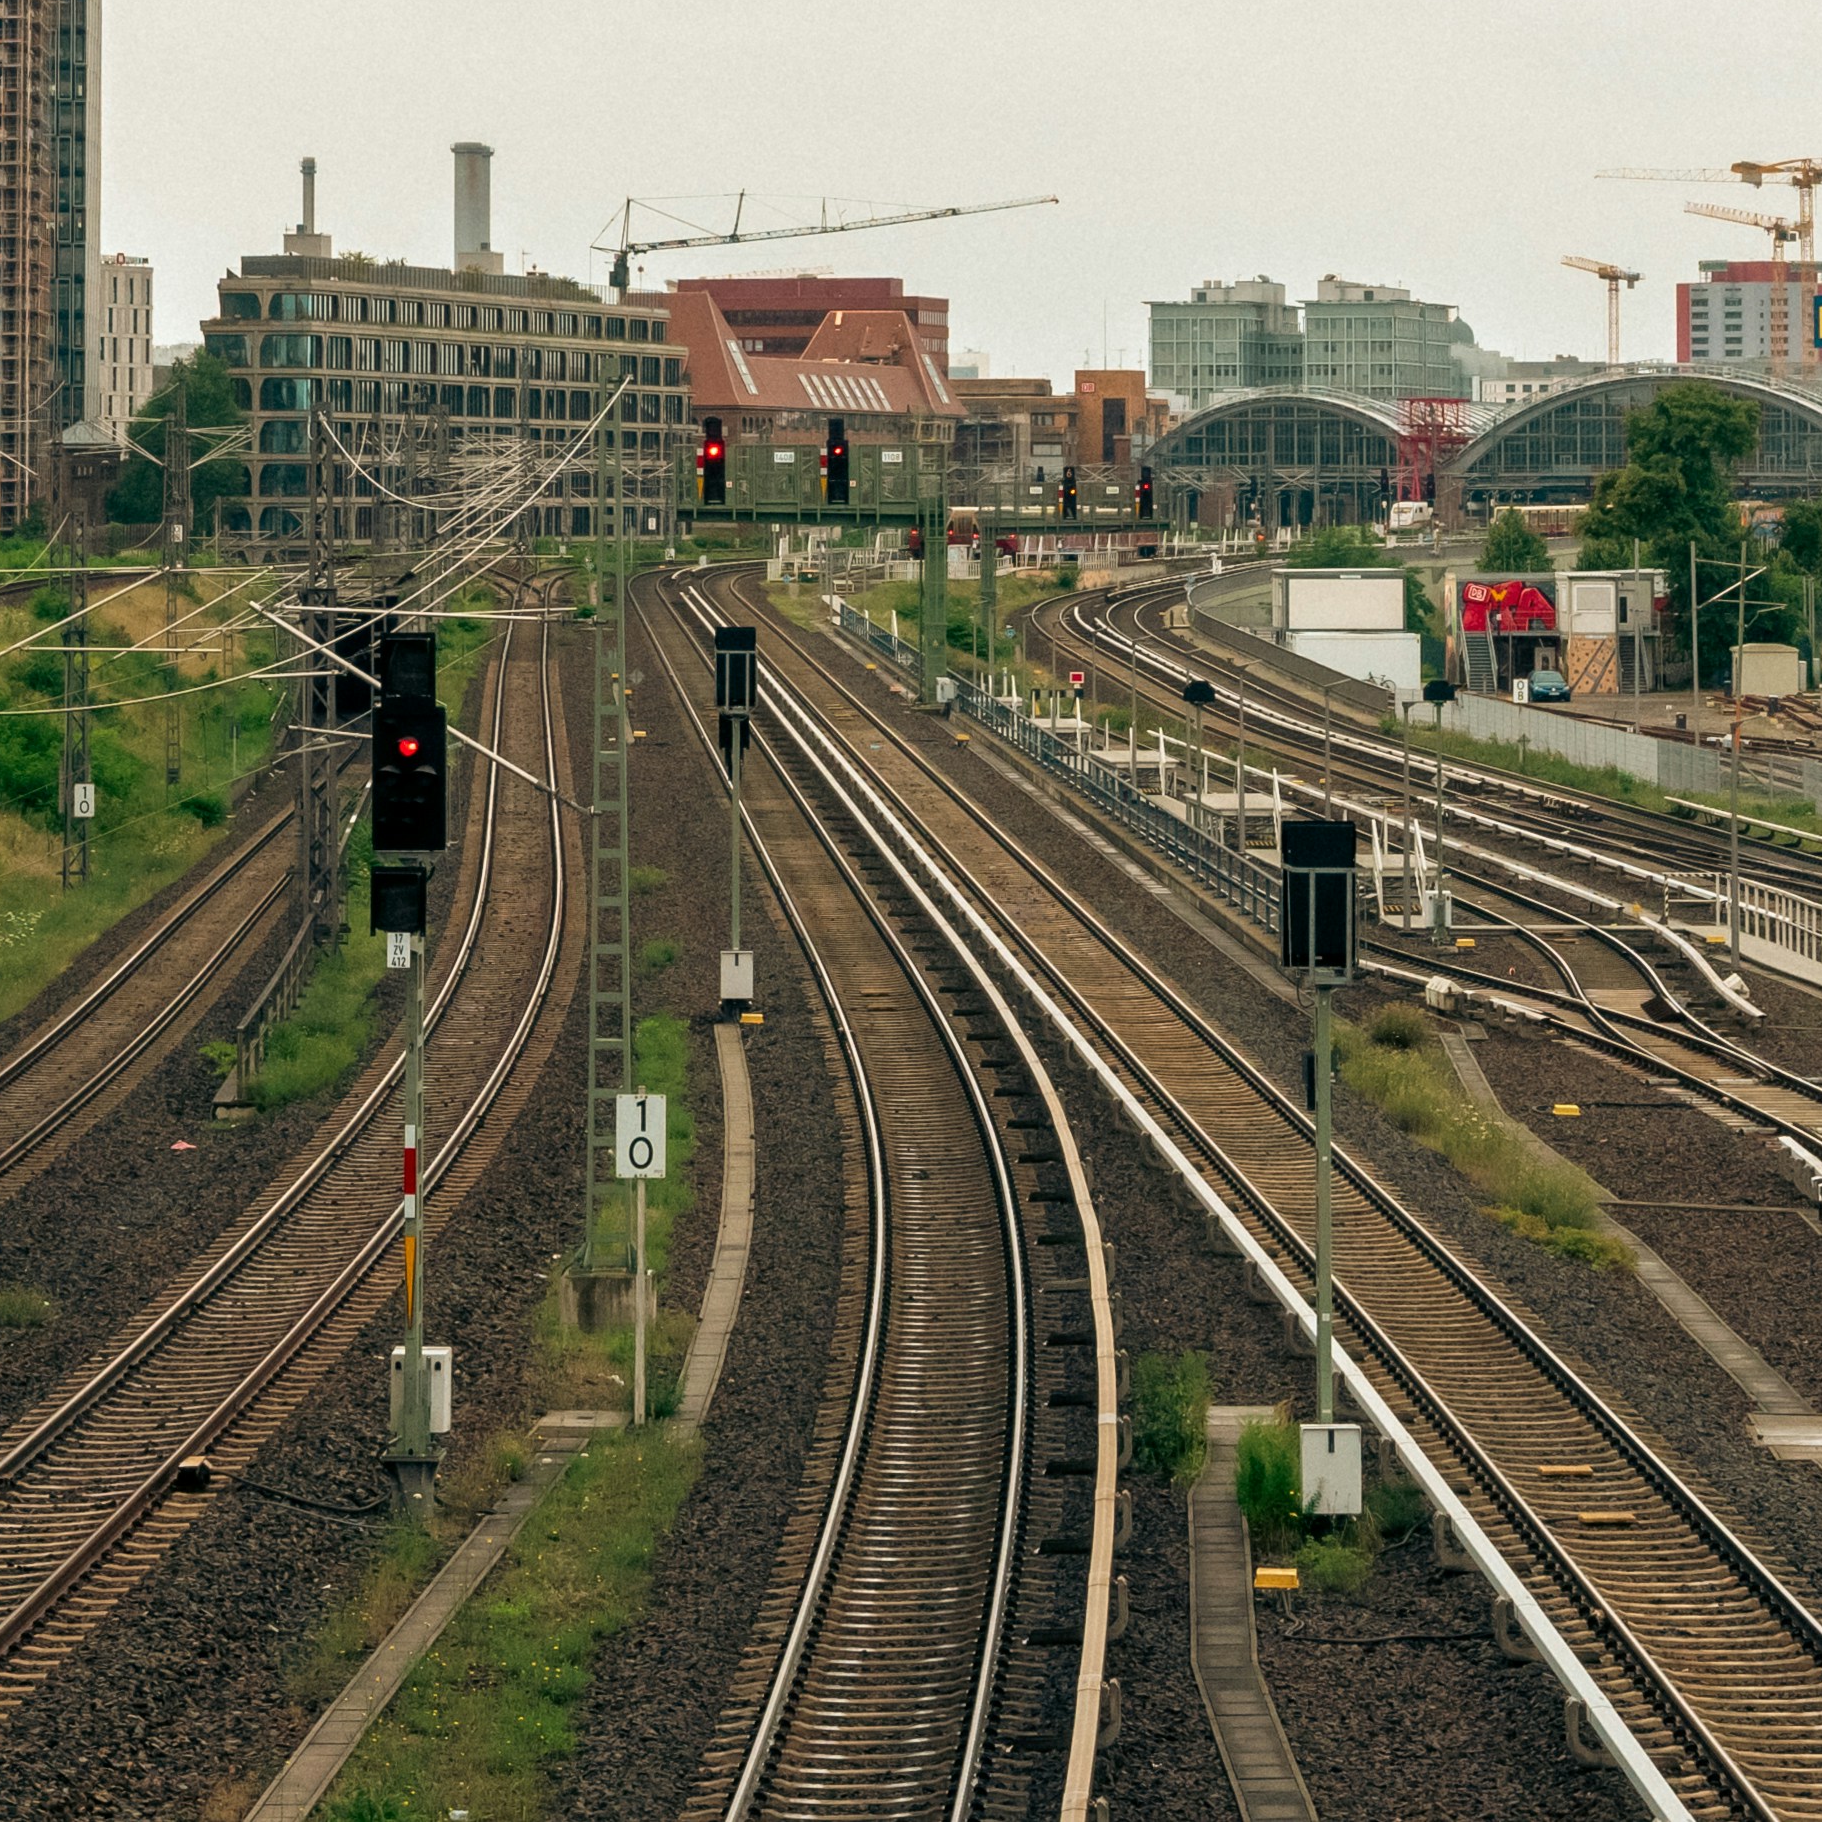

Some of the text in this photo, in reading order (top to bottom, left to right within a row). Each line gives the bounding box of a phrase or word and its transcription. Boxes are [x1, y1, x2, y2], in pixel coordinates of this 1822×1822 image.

[1471, 587, 1483, 599] DB
[82, 786, 87, 799] 1
[79, 800, 90, 814] 0
[395, 933, 403, 943] 17
[394, 945, 404, 955] ZV
[391, 957, 406, 967] 412
[636, 1099, 647, 1132] 1
[629, 1136, 653, 1169] 0
